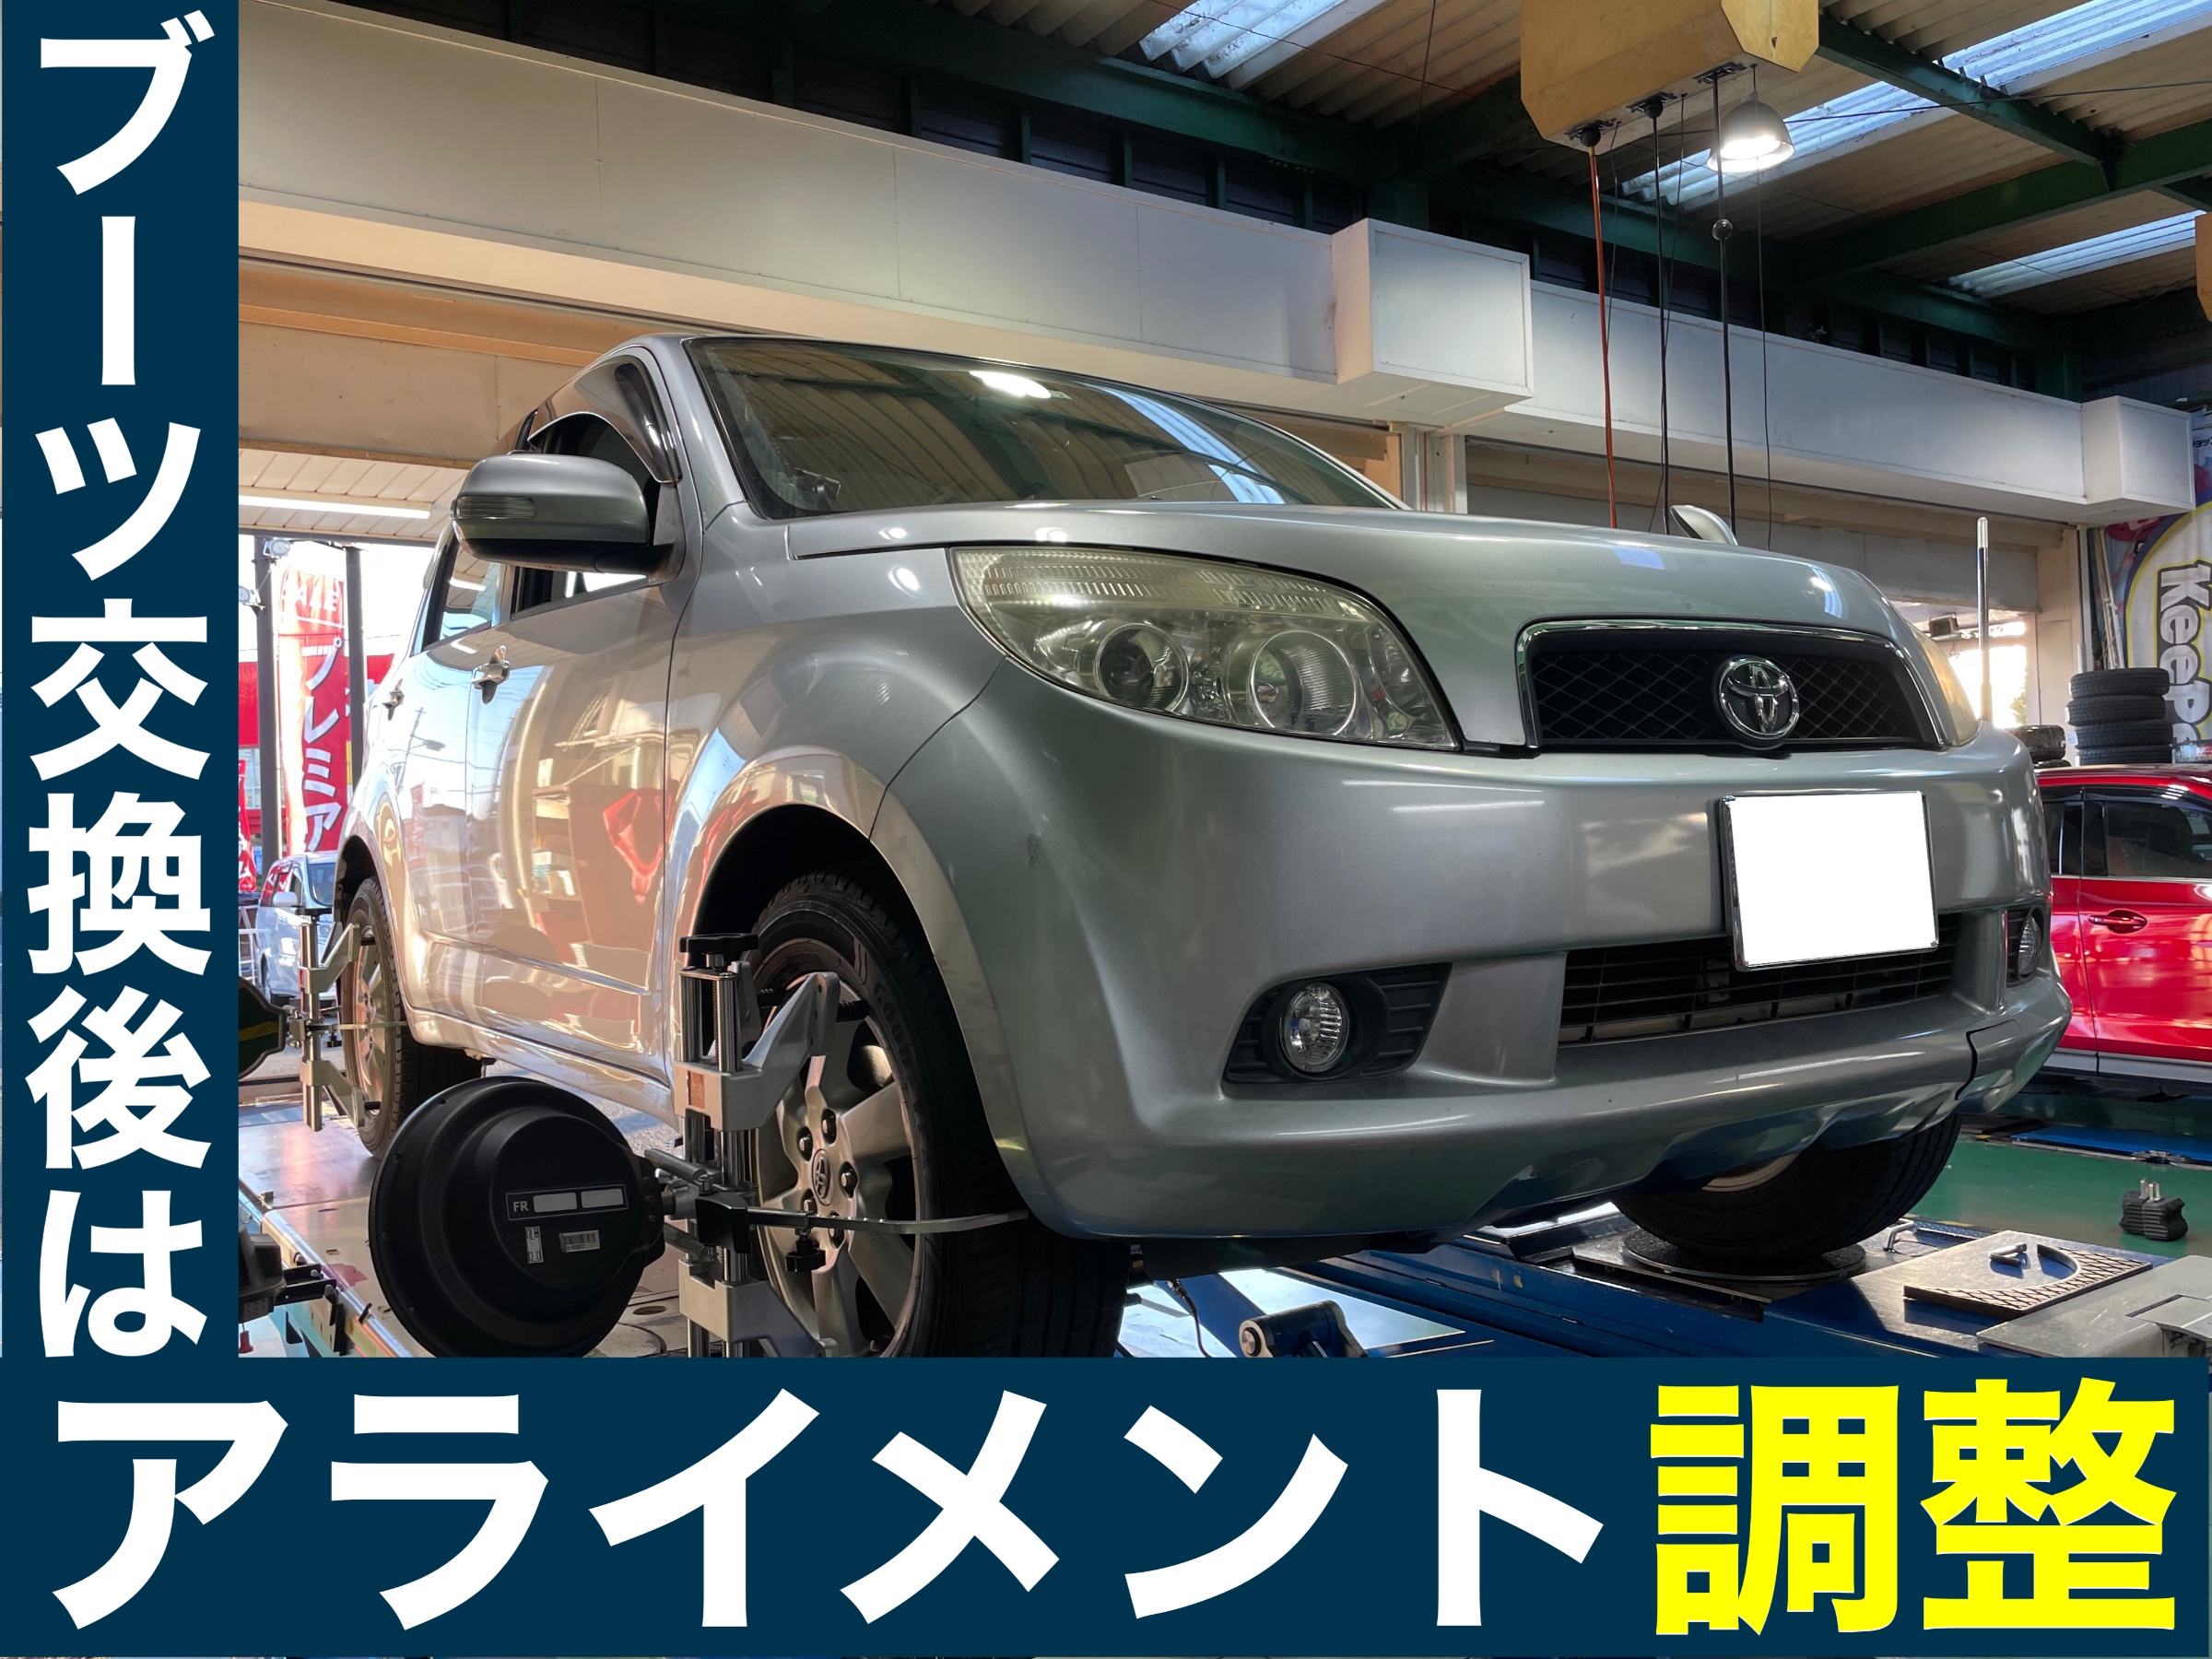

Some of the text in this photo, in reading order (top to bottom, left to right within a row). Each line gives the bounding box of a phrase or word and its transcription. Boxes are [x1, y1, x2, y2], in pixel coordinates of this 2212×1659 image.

[301, 636, 343, 853] プレミア
[512, 1200, 529, 1213] FR
